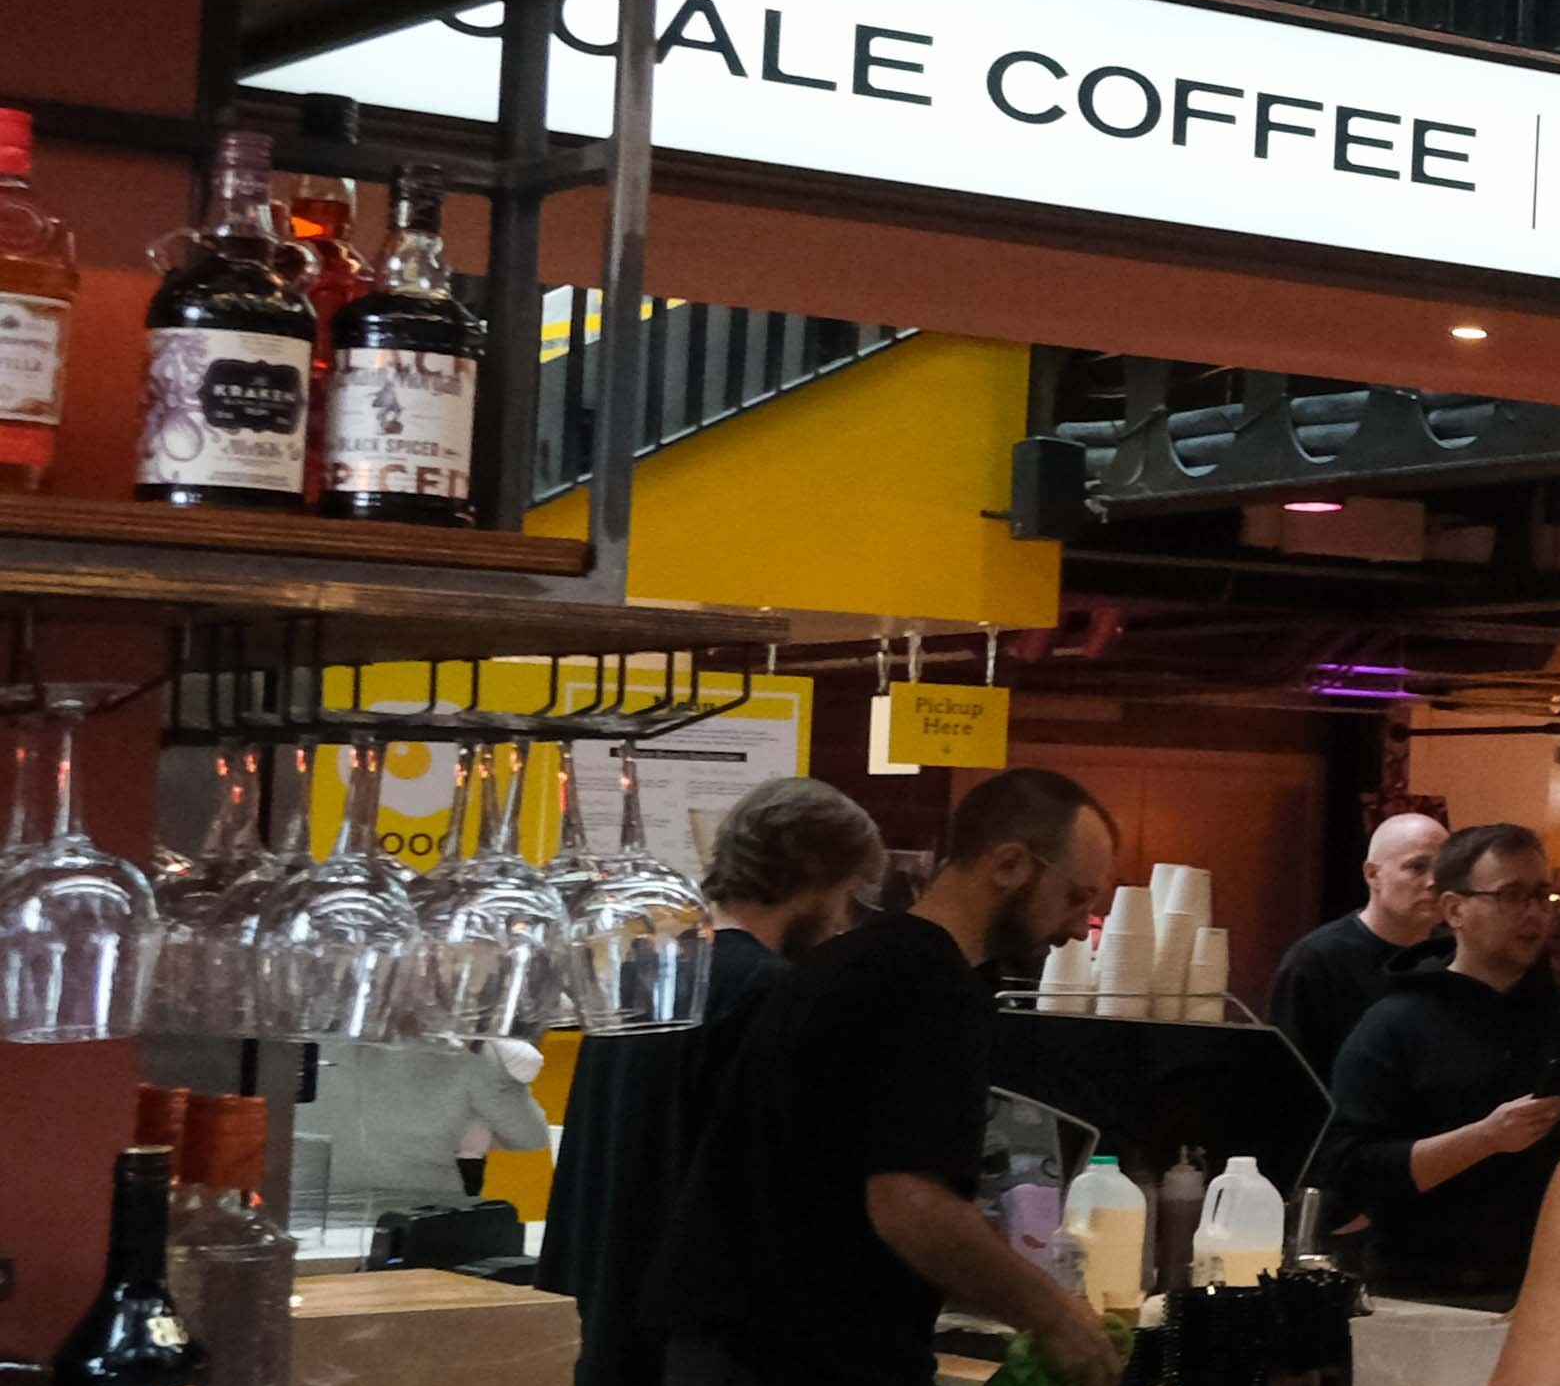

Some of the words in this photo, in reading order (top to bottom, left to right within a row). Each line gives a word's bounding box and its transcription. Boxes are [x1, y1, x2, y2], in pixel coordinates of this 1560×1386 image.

[986, 49, 1477, 192] COFFEE
[915, 696, 984, 719] Pickup
[922, 717, 974, 735] Here
